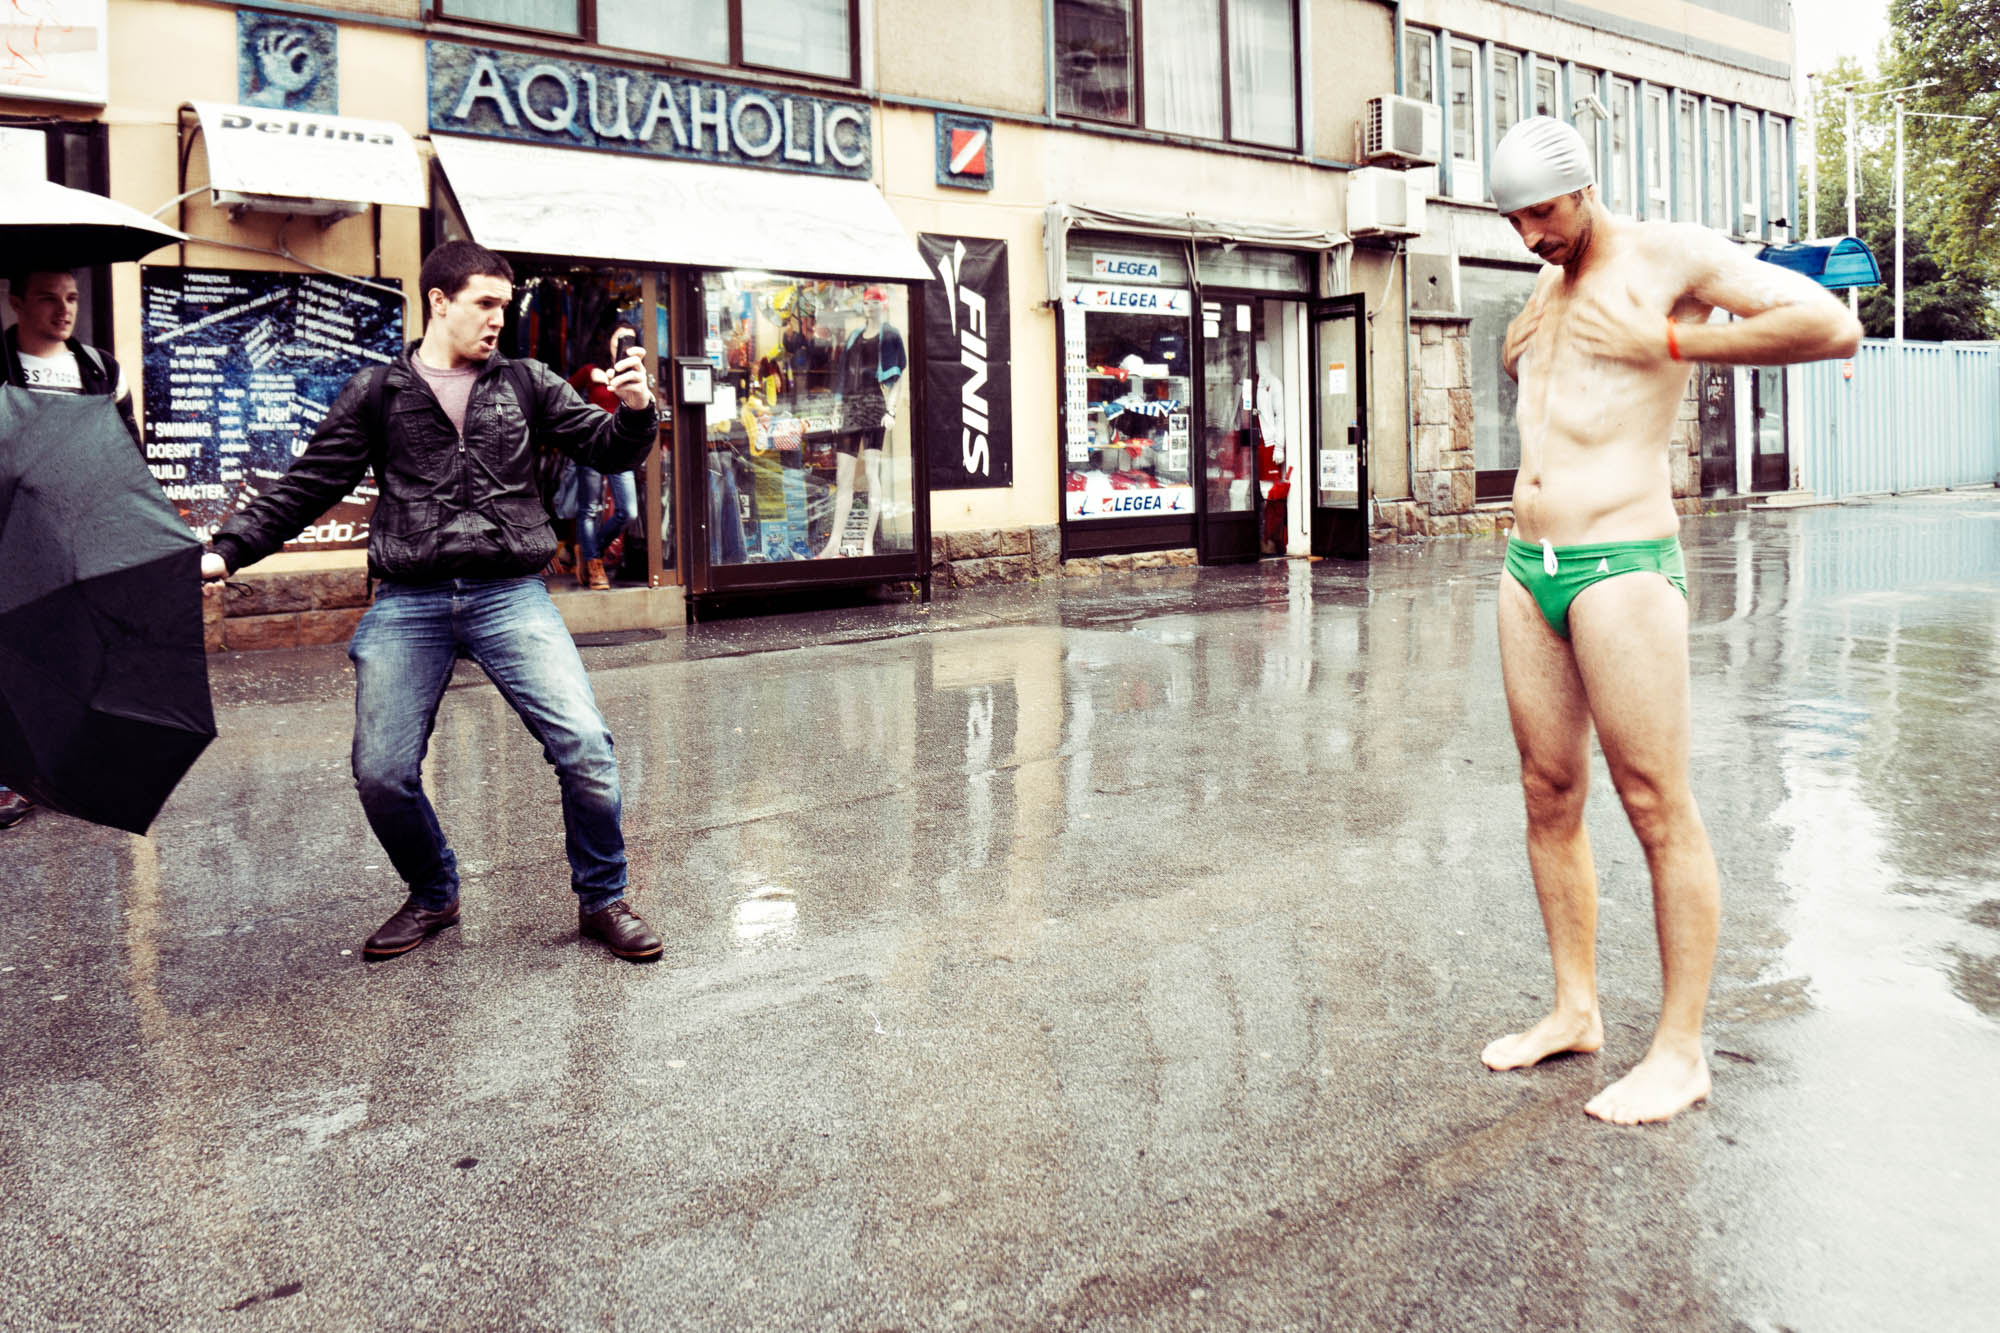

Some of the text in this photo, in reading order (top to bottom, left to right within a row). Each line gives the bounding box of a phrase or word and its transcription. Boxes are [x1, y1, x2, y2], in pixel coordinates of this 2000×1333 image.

[453, 55, 865, 167] AQUAHOLIC
[220, 113, 394, 146] Delfina
[1107, 260, 1158, 278] LEGEA
[1110, 291, 1157, 308] LEGEA
[959, 284, 990, 477] FINIS
[256, 407, 290, 422] PUSH
[155, 422, 212, 438] SWIMING
[146, 442, 202, 458] DOESN'T
[1114, 496, 1161, 512] LEGEA
[298, 520, 352, 544] edo
